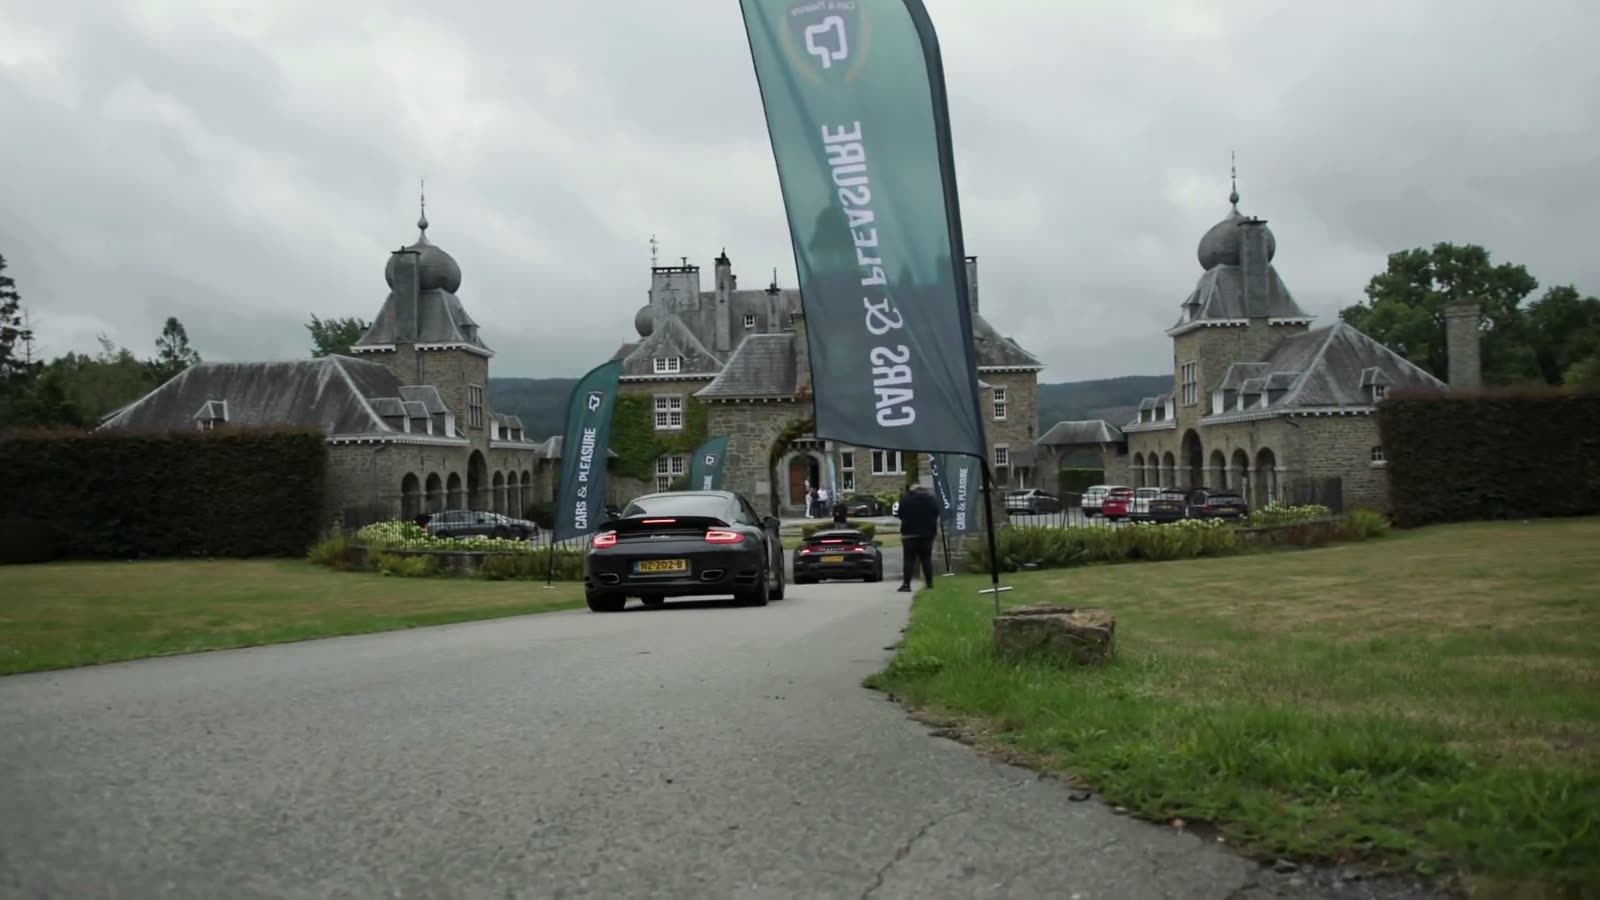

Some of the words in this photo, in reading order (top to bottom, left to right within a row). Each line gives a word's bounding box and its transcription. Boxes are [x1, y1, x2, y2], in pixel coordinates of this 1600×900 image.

[579, 428, 596, 482] PLEASURE
[577, 486, 588, 498] &
[958, 467, 968, 501] PLEASURE
[575, 501, 588, 529] CARS
[957, 502, 966, 511] &
[956, 512, 966, 530] CARS
[641, 560, 683, 570] NZ-202-B
